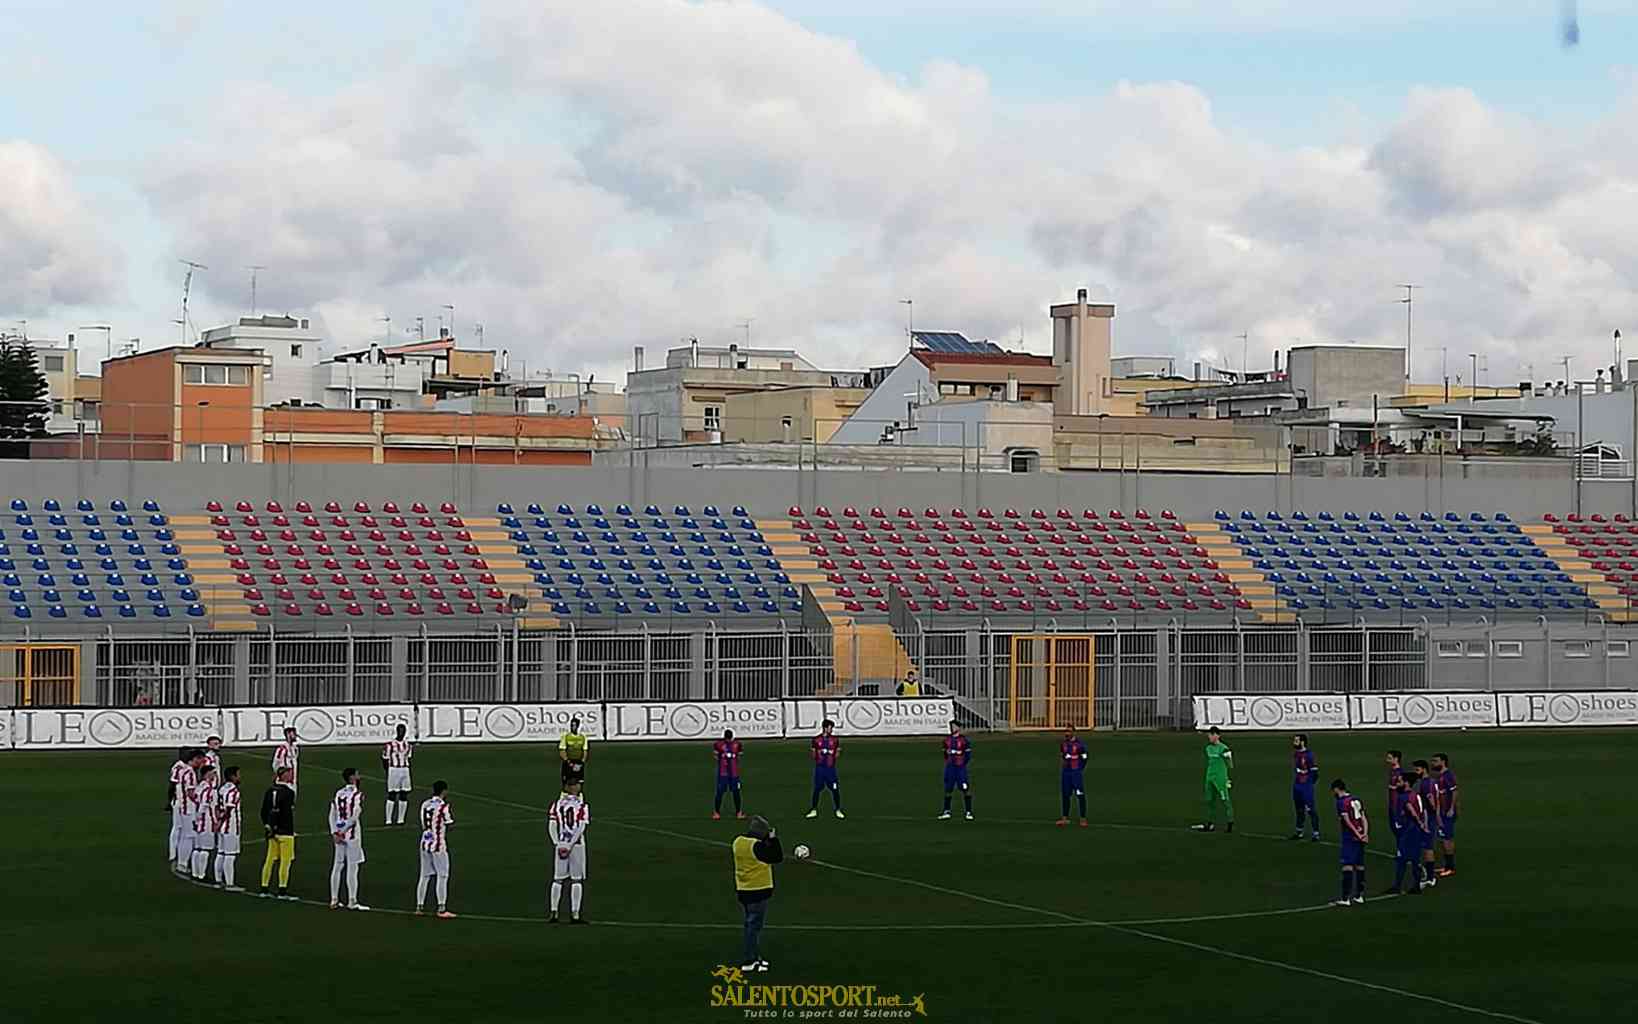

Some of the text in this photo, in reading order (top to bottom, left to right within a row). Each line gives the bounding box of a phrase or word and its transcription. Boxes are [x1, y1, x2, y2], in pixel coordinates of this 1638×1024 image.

[883, 700, 949, 717] shoes
[1284, 698, 1343, 714] shoes
[1435, 696, 1492, 712] shoes
[1581, 694, 1637, 710] shoes
[135, 711, 213, 730] shoes
[335, 709, 409, 727] shoes
[709, 705, 777, 722] shoes
[559, 805, 575, 830] 10
